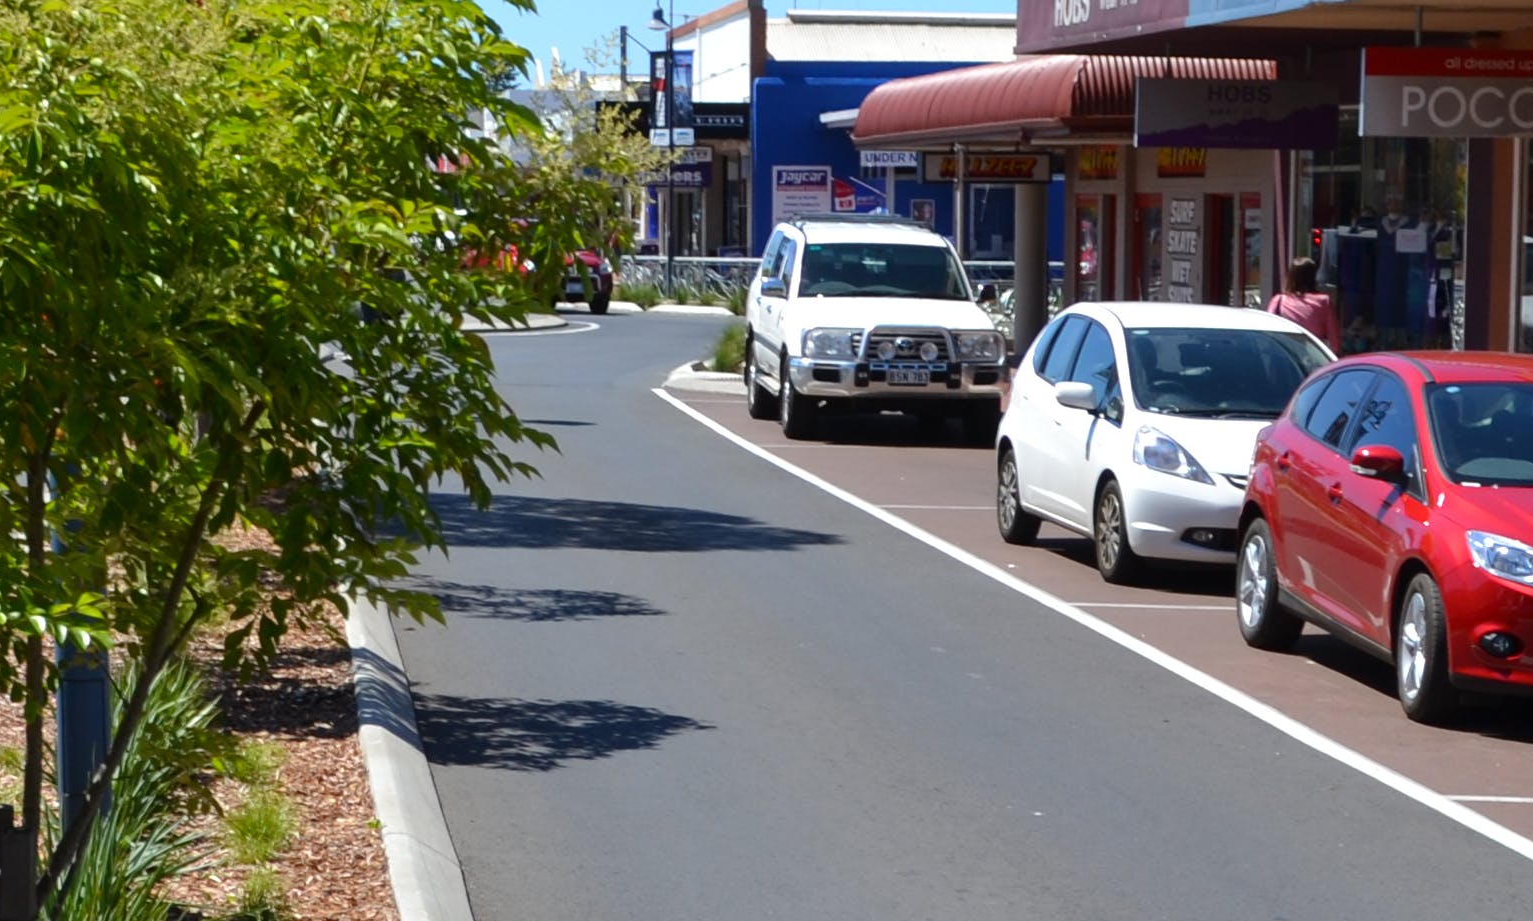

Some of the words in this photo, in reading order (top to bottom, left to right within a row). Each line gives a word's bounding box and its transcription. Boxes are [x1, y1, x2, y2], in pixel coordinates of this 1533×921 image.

[1054, 0, 1091, 27] HOBS
[1444, 57, 1461, 70] all
[1464, 57, 1515, 70] dressed
[1208, 84, 1273, 105] HOBS
[865, 151, 904, 164] UNDER
[1169, 200, 1195, 223] SURF
[1167, 229, 1197, 253] SKATE
[1171, 260, 1192, 282] WET
